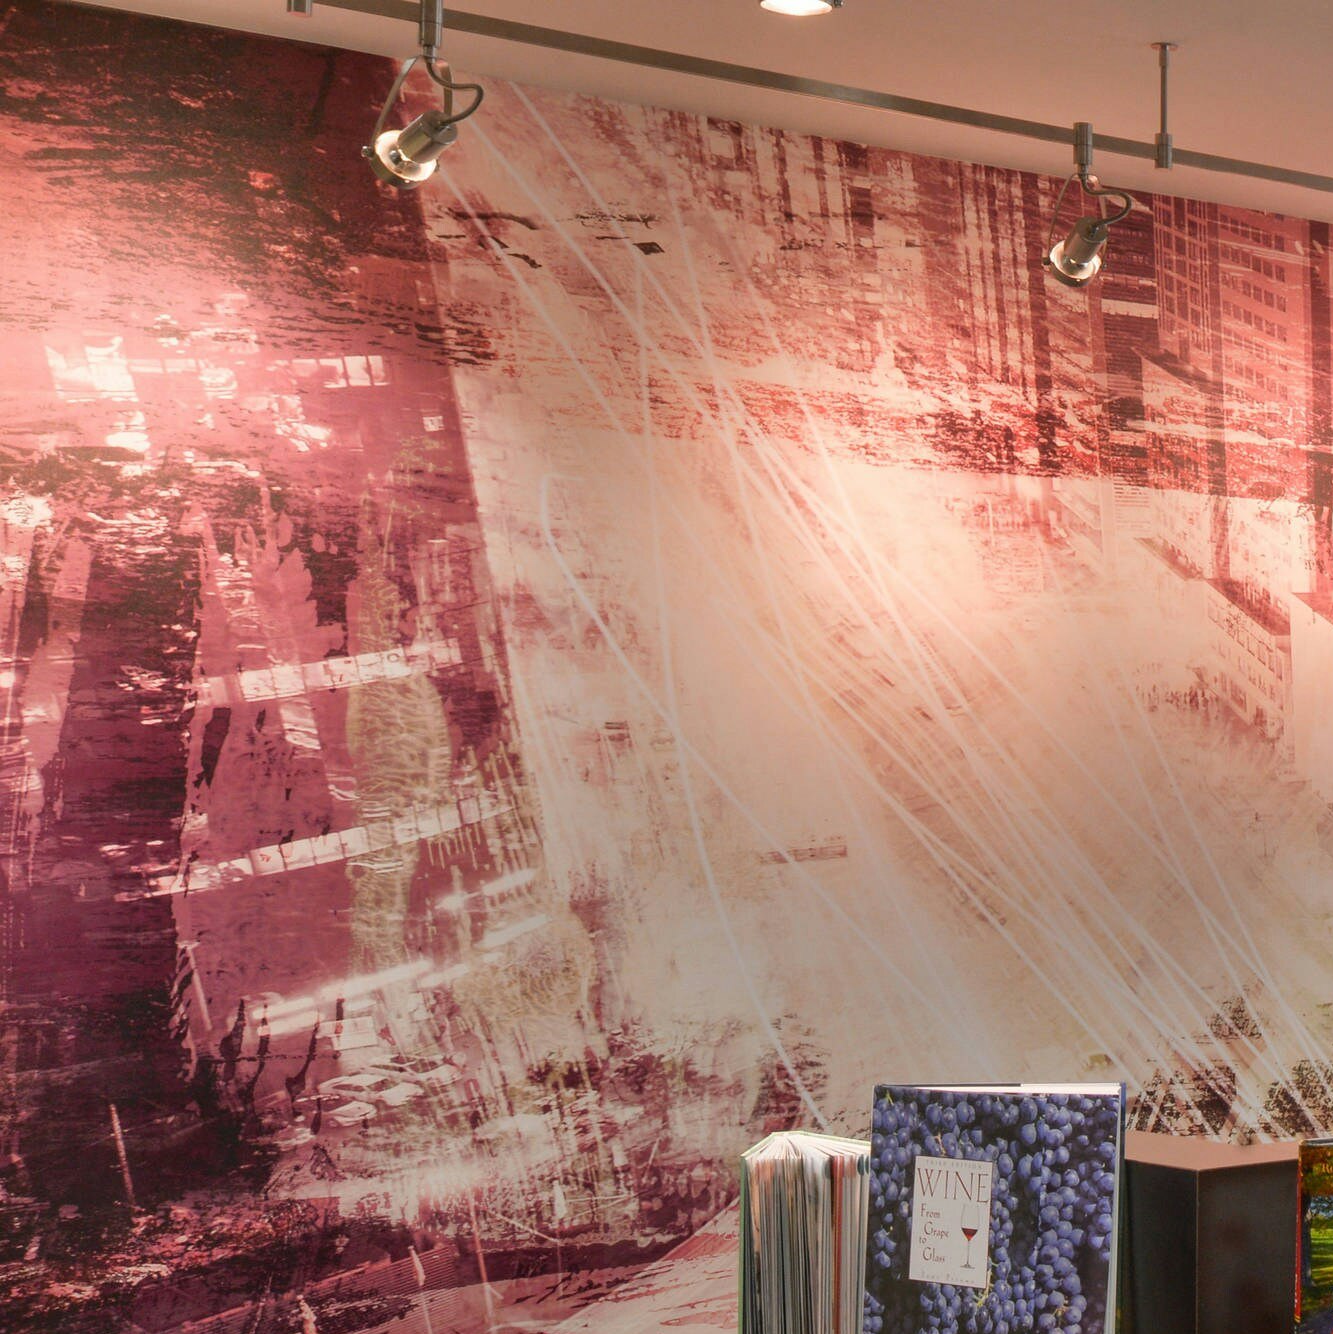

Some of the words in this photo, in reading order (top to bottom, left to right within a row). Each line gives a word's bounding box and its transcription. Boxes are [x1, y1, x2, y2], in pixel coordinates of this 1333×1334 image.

[917, 1167, 989, 1203] WINE
[920, 1203, 941, 1218] From
[924, 1222, 949, 1239] Grape
[919, 1236, 927, 1244] to
[922, 1247, 946, 1263] Glass
